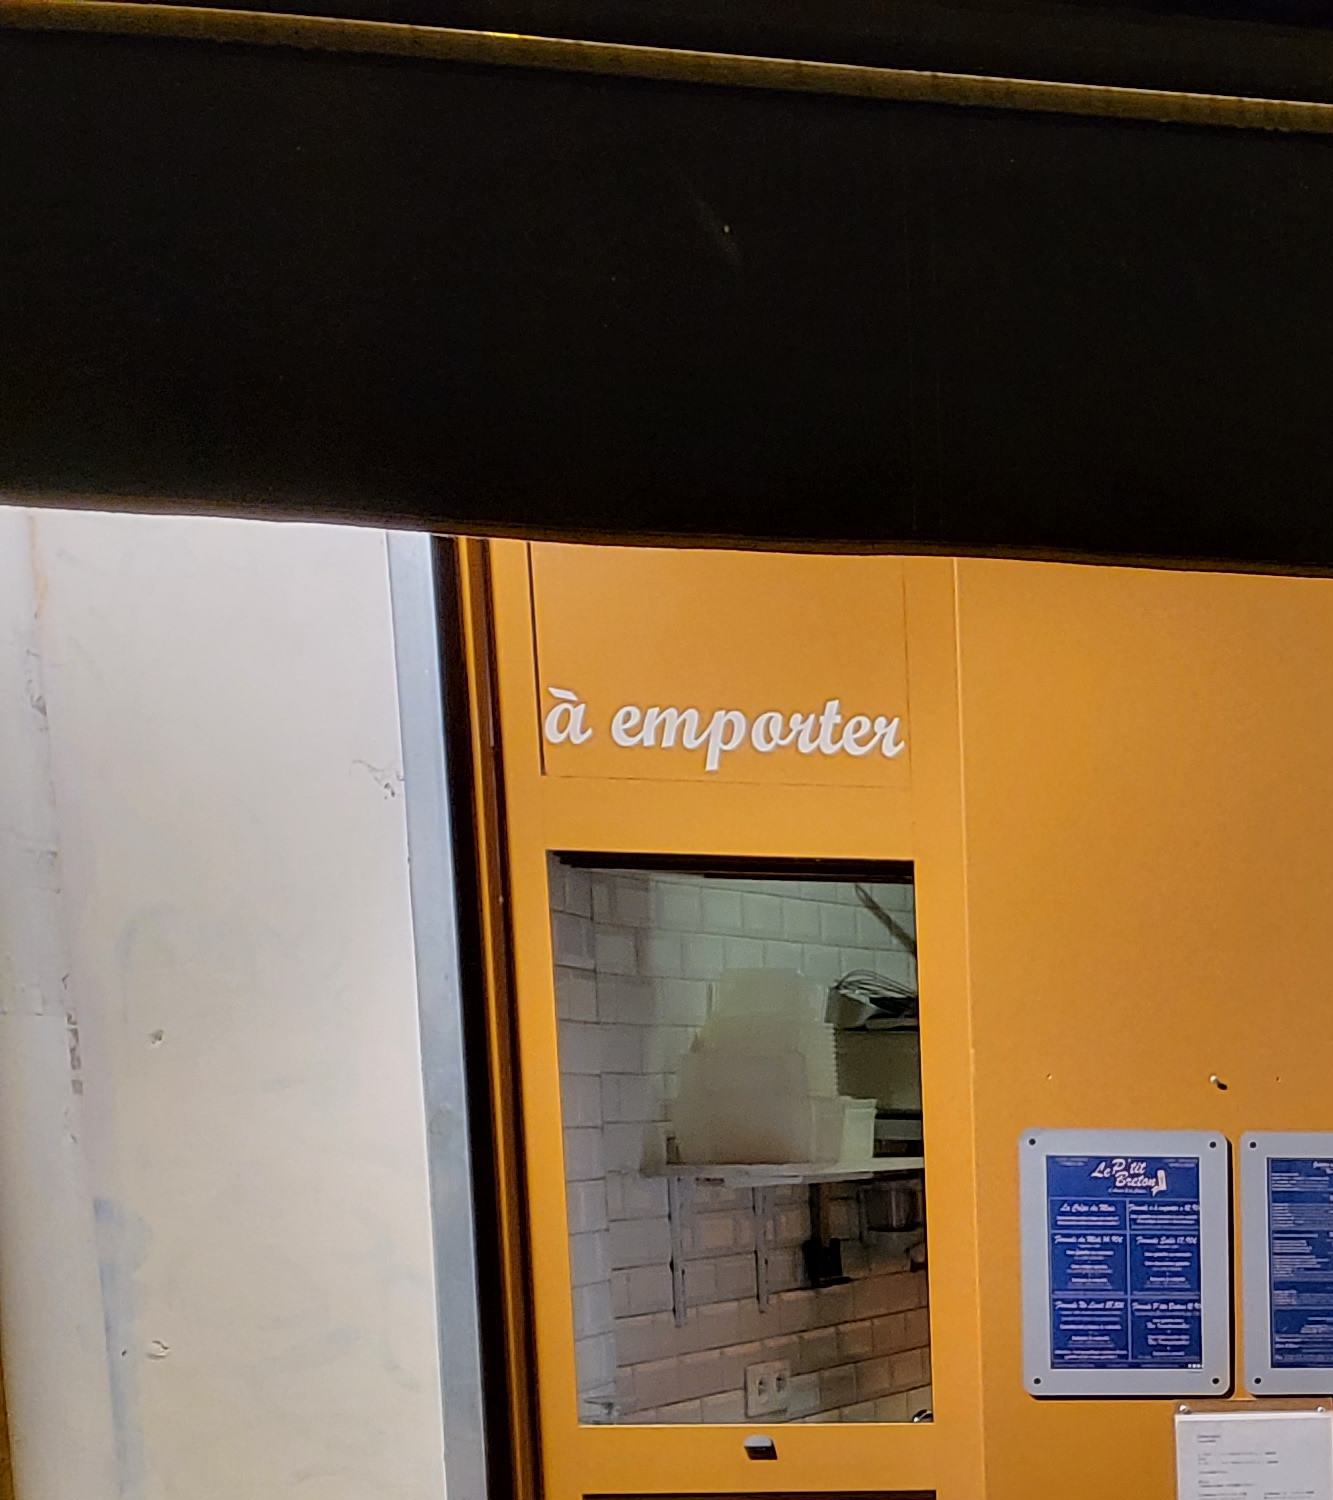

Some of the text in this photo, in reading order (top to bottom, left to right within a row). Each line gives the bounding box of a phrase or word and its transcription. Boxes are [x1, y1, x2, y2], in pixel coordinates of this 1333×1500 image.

[544, 687, 905, 771] à emporter
[1090, 1161, 1111, 1178] Le
[1114, 1172, 1157, 1187] Breton
